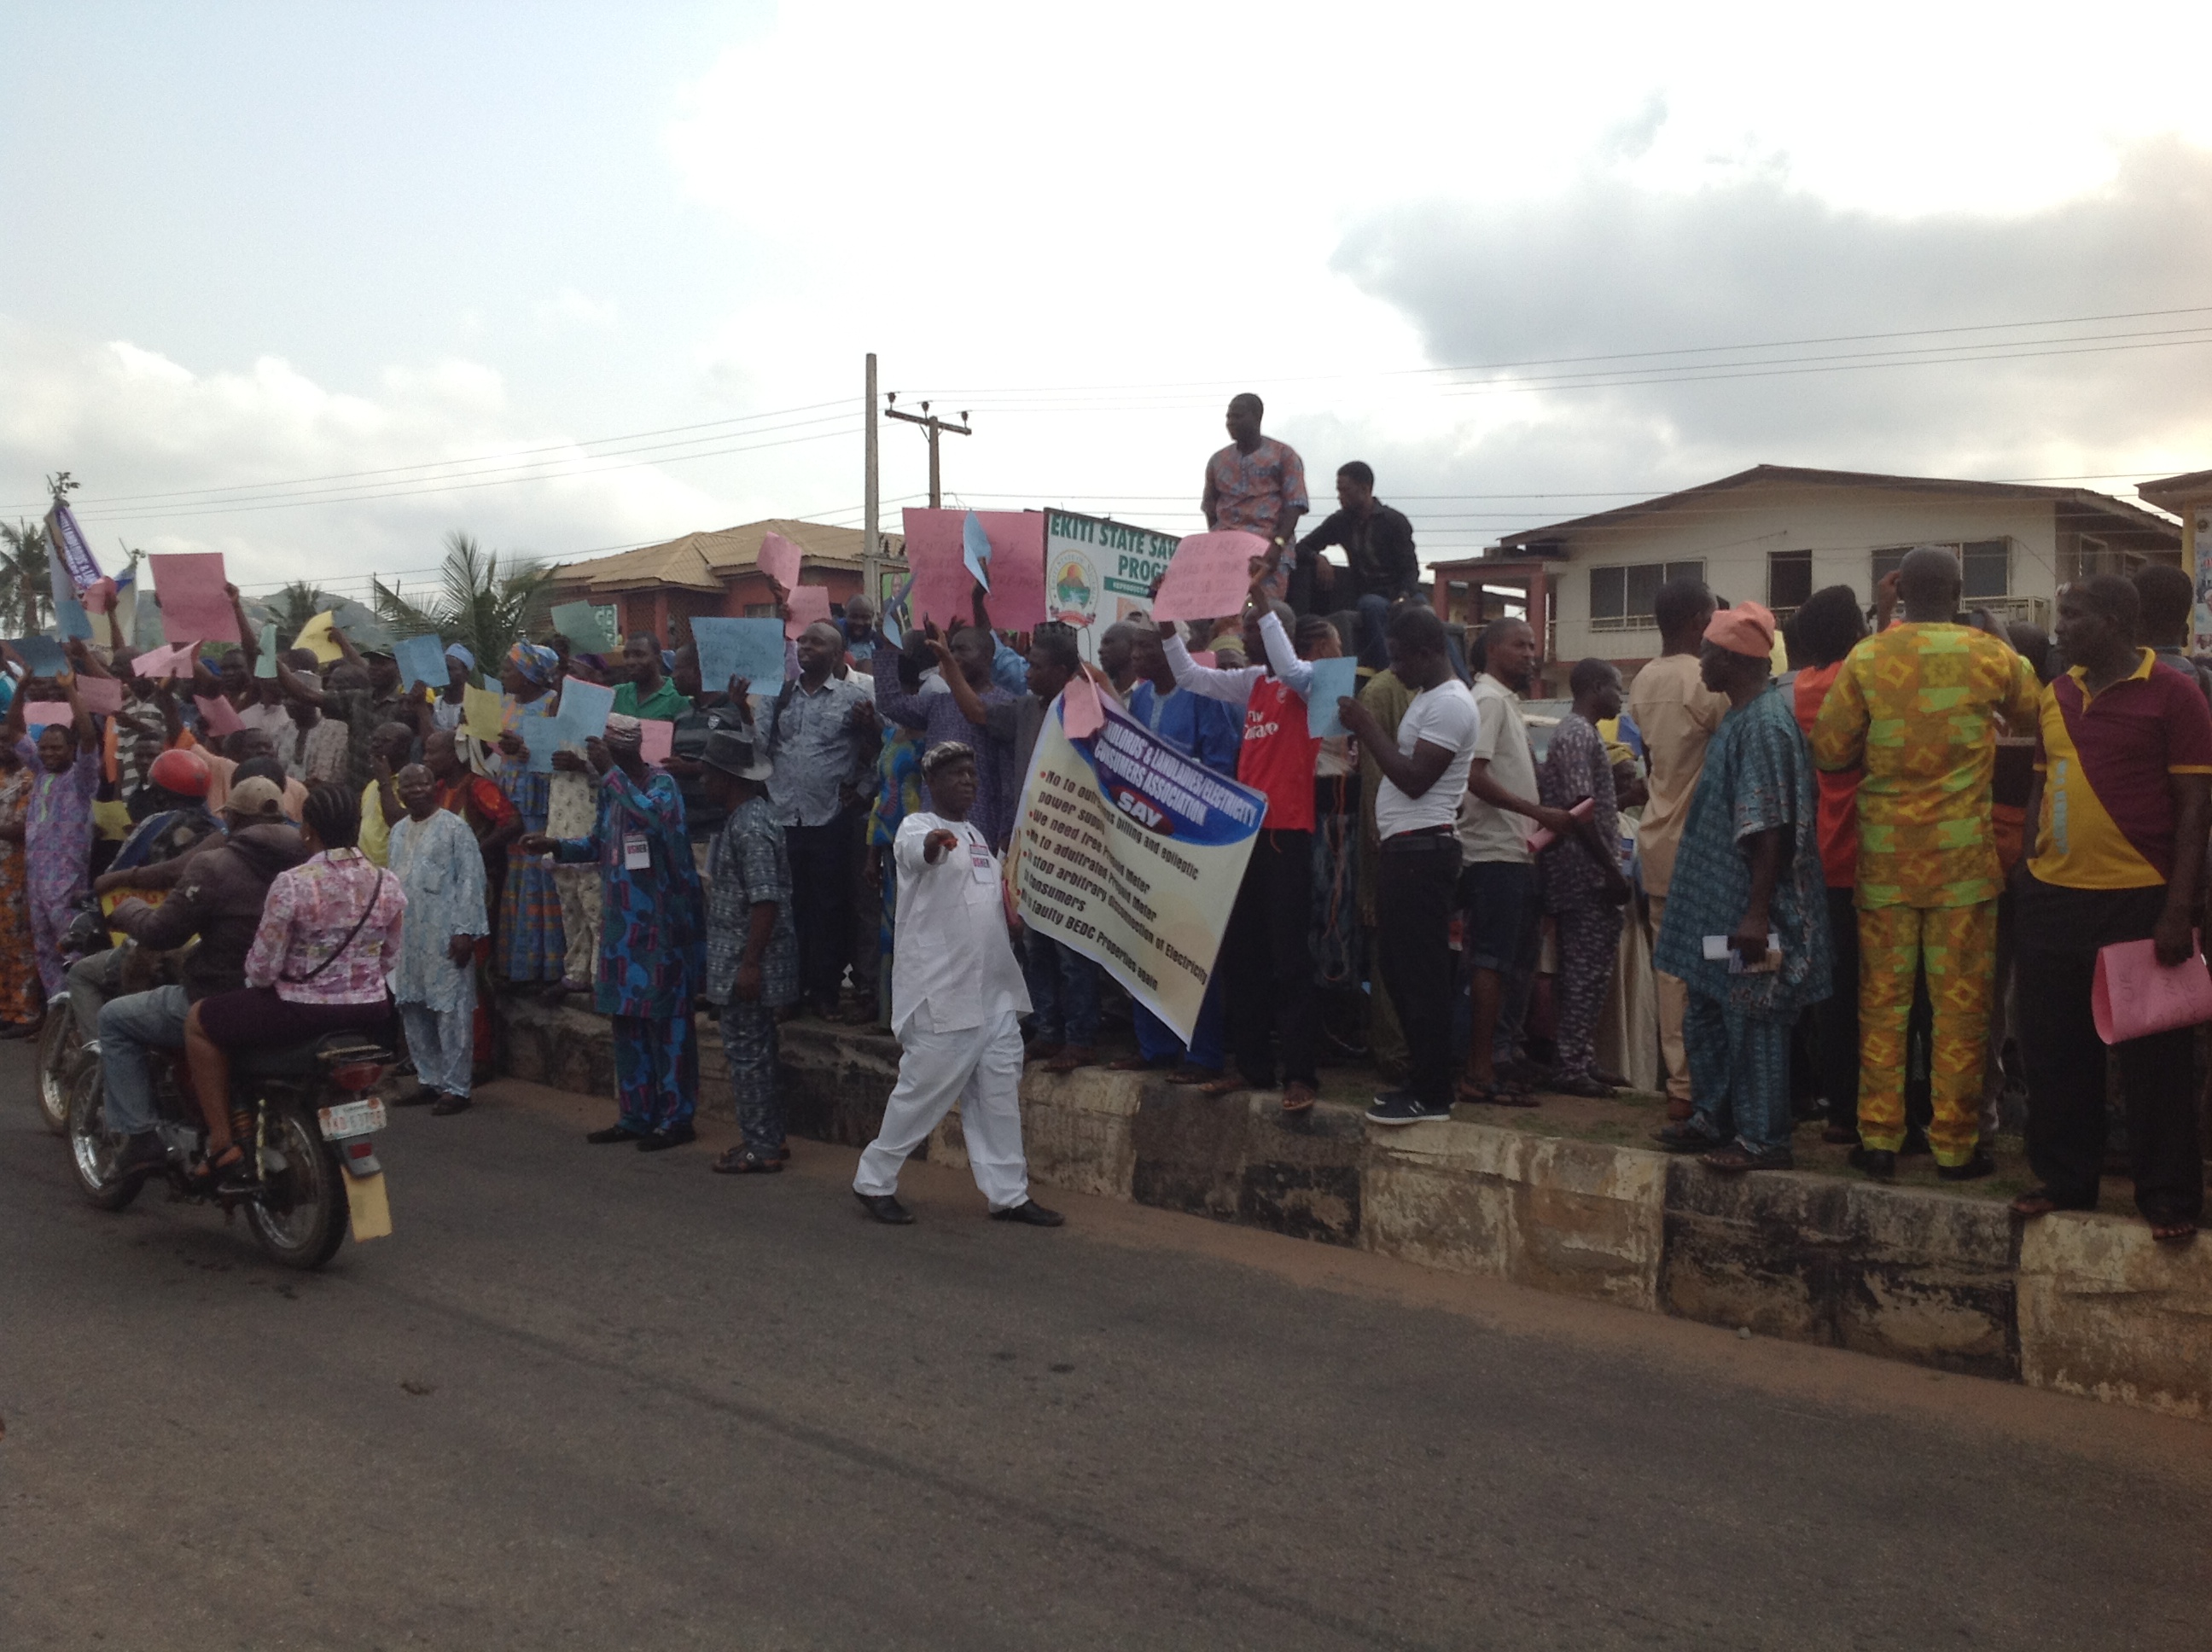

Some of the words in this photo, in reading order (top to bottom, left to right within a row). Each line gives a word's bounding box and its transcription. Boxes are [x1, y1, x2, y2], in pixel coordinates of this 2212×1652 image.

[1050, 514, 1094, 544] EKITI
[1099, 523, 1144, 554] STATE
[1143, 747, 1154, 765] &
[1038, 790, 1077, 815] power
[1045, 771, 1061, 787] No
[1062, 778, 1076, 794] to
[1115, 816, 1143, 844] billing
[1144, 836, 1160, 854] and
[1116, 791, 1162, 828] SAY
[1142, 772, 1208, 826] ASSOCIATION
[1039, 833, 1051, 851] to
[1132, 896, 1156, 922] Meter
[1050, 817, 1080, 841] need
[1080, 831, 1103, 853] free
[1125, 868, 1150, 893] Meter
[1032, 899, 1064, 926] faulty
[1065, 916, 1097, 939] BEDC
[1032, 855, 1055, 875] stop
[1056, 867, 1107, 902] arbitrary
[1155, 937, 1164, 951] of
[1165, 943, 1208, 986] Electricity
